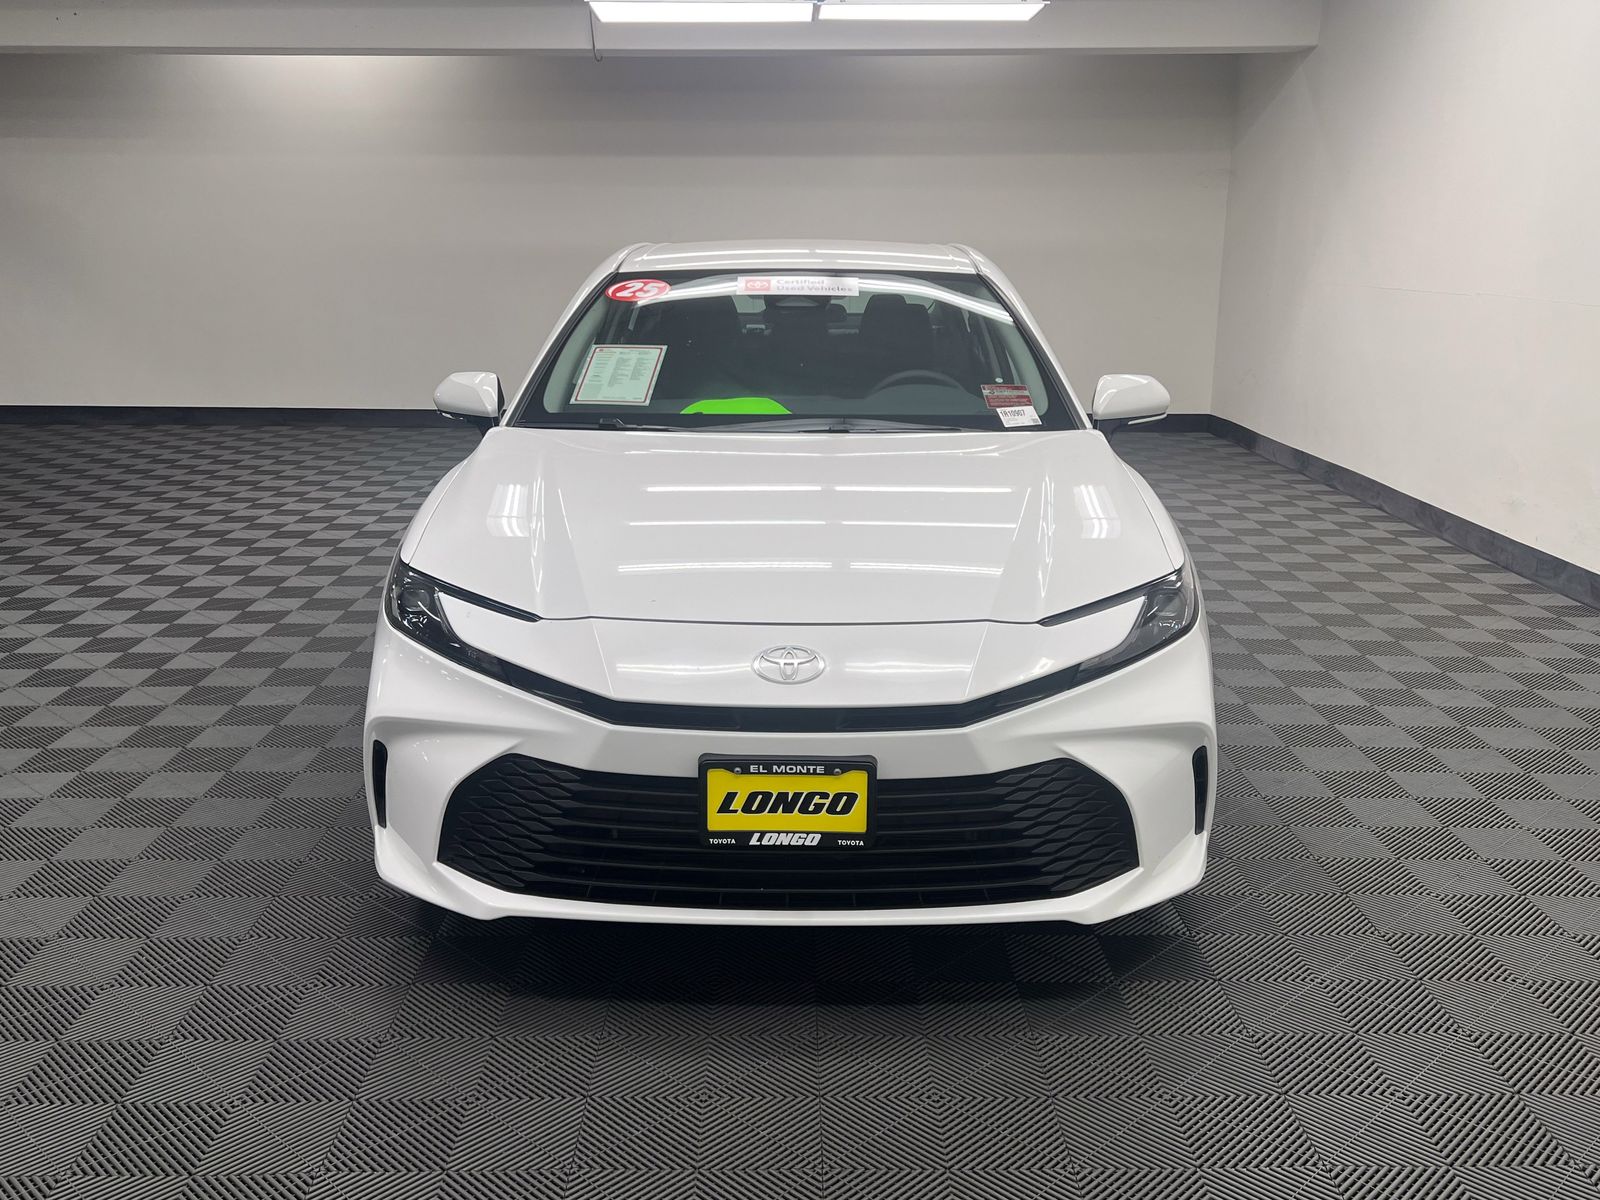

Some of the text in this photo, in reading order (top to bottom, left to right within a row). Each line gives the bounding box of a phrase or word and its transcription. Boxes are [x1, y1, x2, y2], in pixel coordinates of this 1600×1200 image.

[615, 282, 666, 298] 25
[750, 765, 825, 774] EL MONTE
[716, 790, 859, 816] LONGO
[749, 832, 822, 846] LONGO
